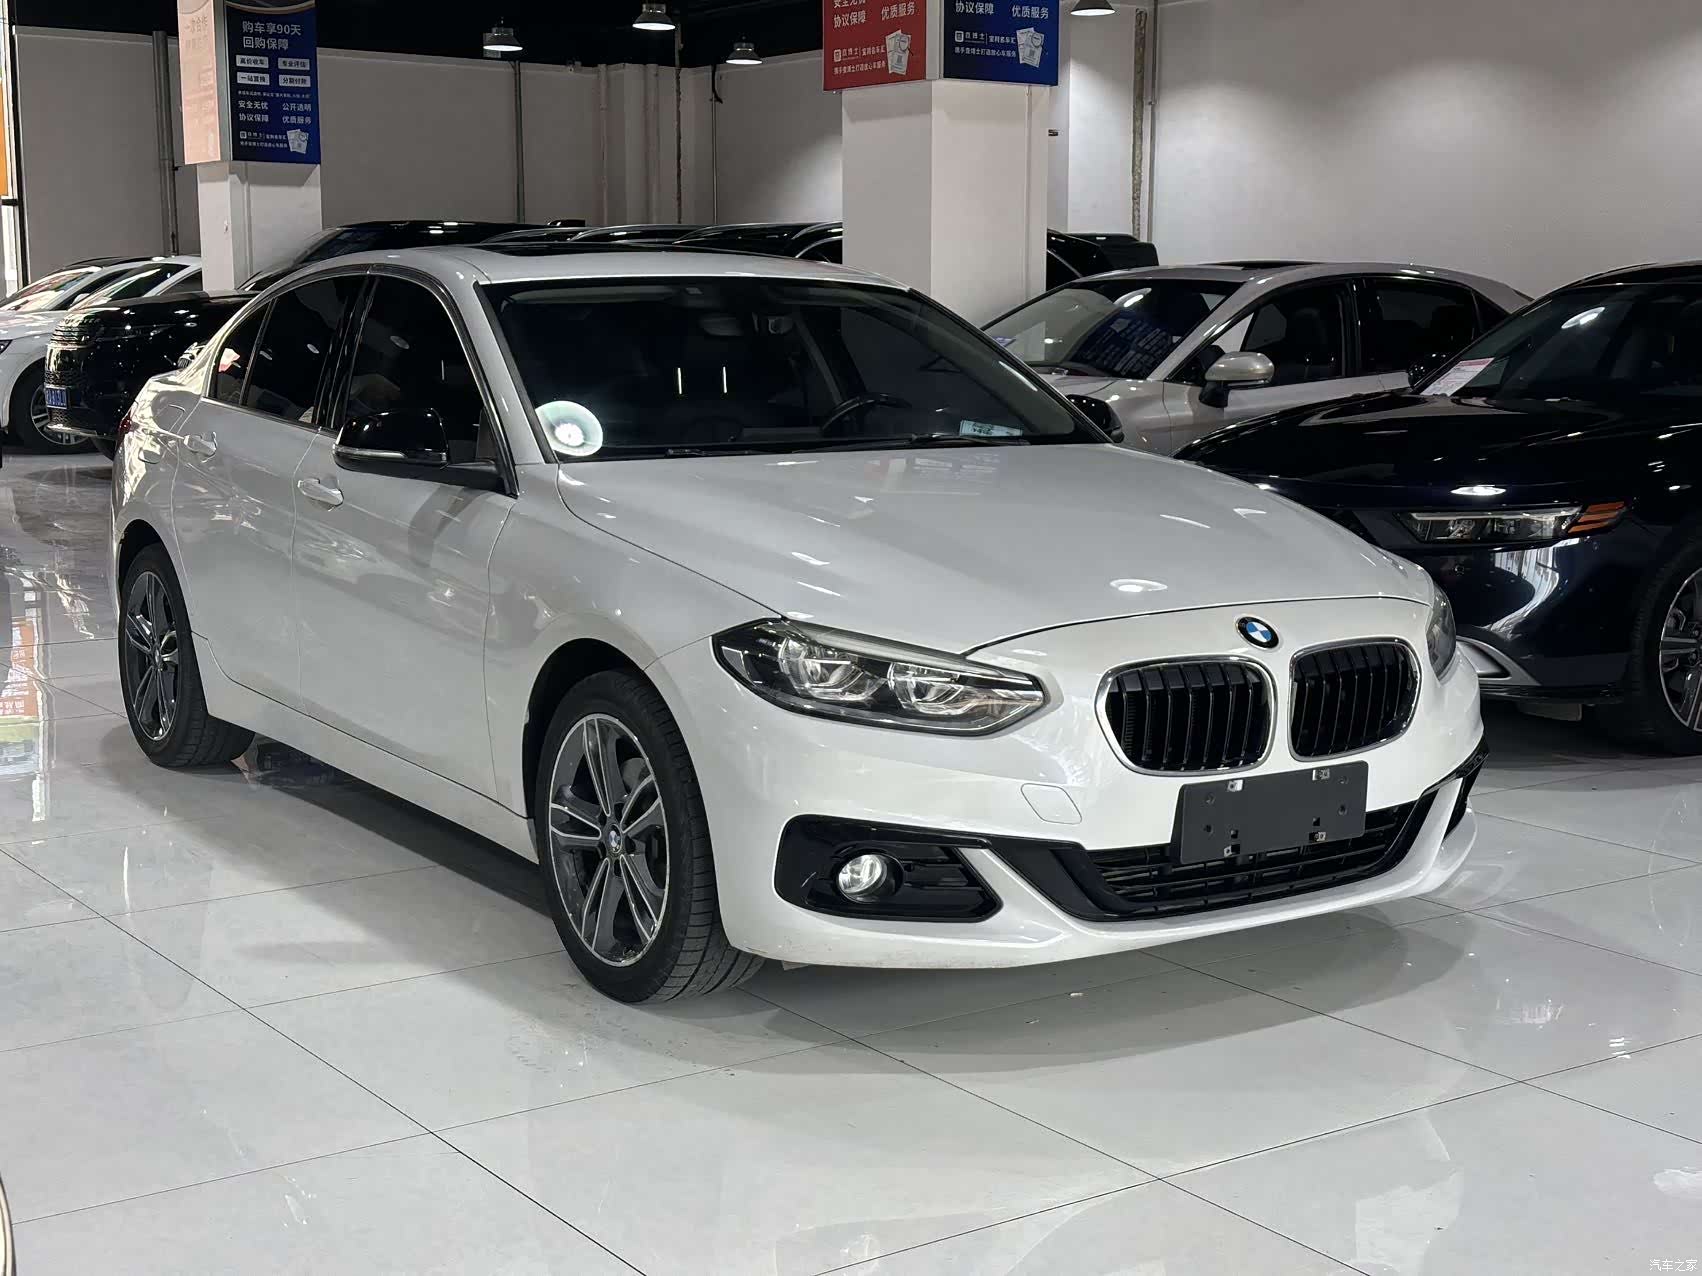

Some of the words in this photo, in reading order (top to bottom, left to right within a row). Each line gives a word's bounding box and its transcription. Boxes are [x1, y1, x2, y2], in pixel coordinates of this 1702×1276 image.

[881, 2, 915, 20] 优质服务
[955, 0, 994, 15] 协议保障
[1011, 5, 1049, 19] 优质服务
[833, 10, 866, 28] 协议保障
[242, 21, 301, 36] 购车享90天
[243, 36, 289, 50] 回购保障
[238, 100, 268, 110] 安全无忧
[282, 102, 312, 112] 公开透明
[239, 113, 269, 122] 协议保障
[282, 115, 312, 125] 优质服务
